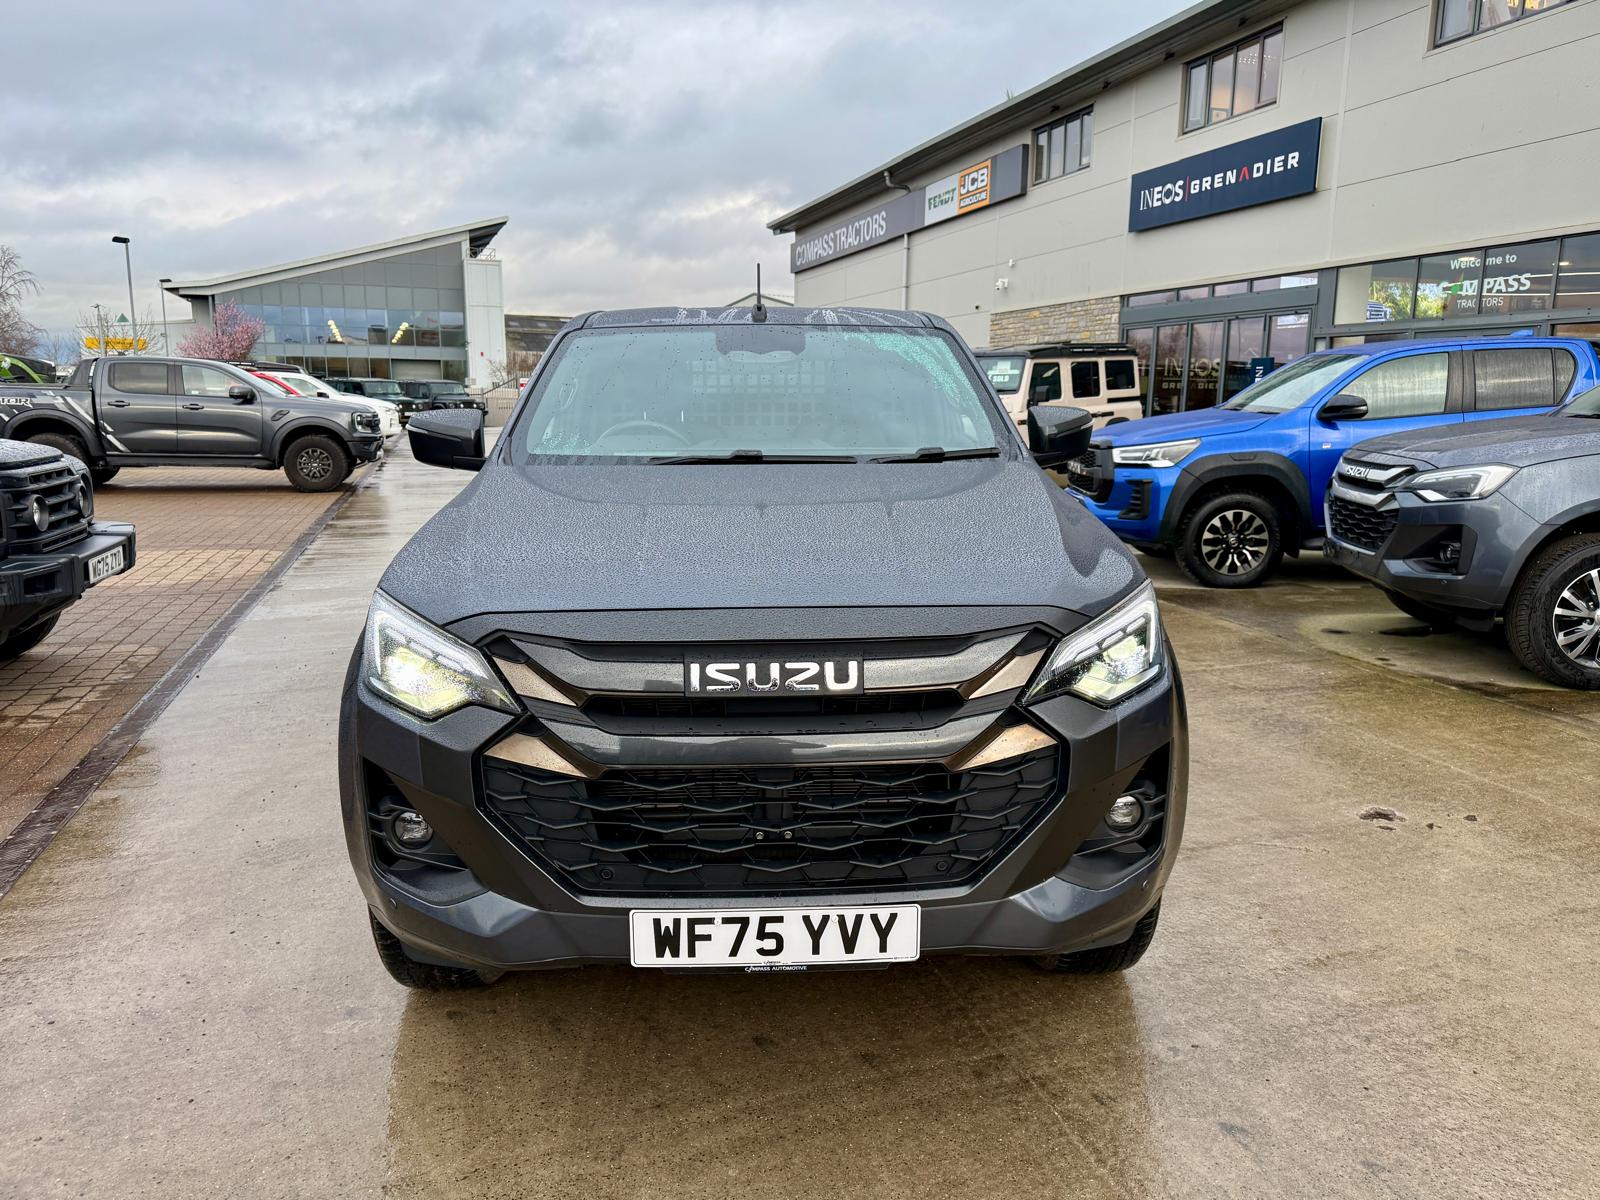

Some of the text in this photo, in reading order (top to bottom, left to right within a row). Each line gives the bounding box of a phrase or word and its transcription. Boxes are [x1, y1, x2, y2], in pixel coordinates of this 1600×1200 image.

[960, 168, 988, 194] JCB
[1139, 151, 1299, 211] INEOS GRENADIER
[927, 187, 956, 211] FENDT
[959, 190, 987, 208] AGRICULTURE
[795, 210, 887, 266] COMPASS TRACTORS
[1450, 253, 1517, 271] Welcome to
[1457, 296, 1504, 309] TRACTORS
[92, 555, 109, 579] WG75
[690, 660, 858, 692] ISUZU
[652, 912, 898, 958] WF75 YVY
